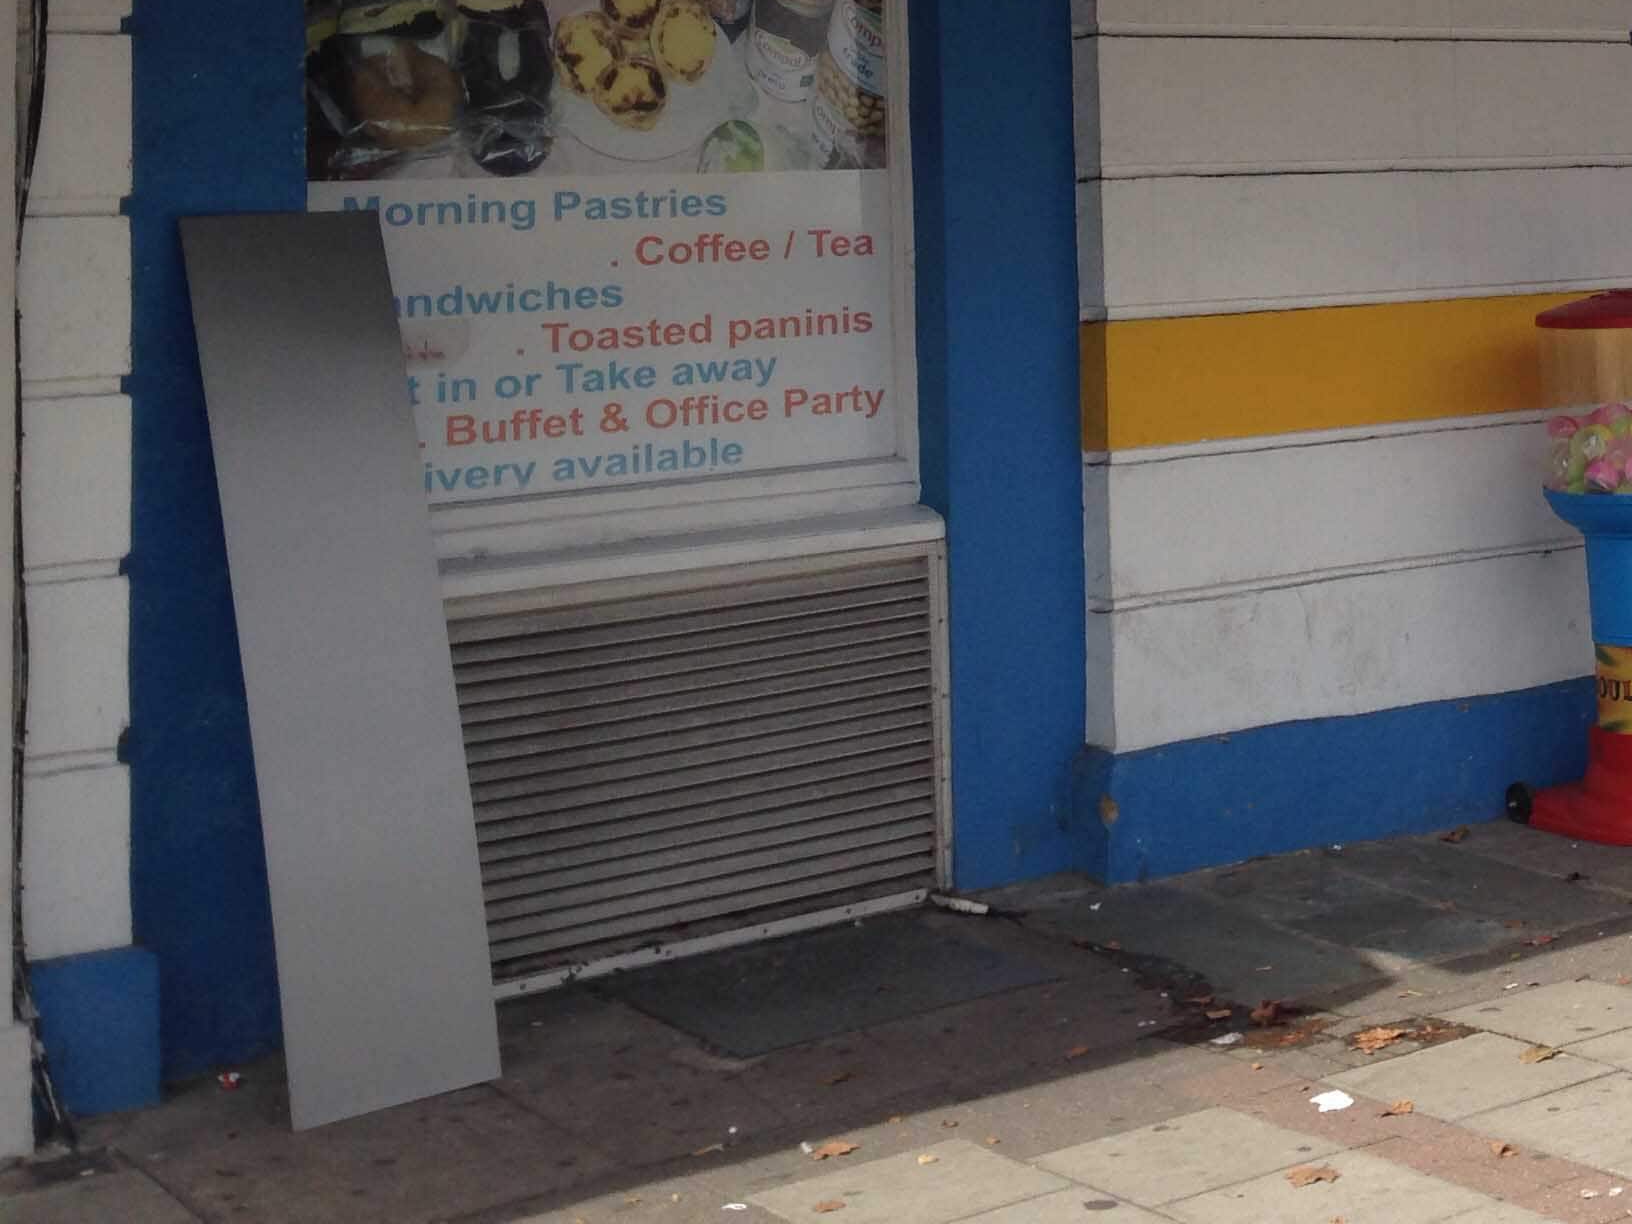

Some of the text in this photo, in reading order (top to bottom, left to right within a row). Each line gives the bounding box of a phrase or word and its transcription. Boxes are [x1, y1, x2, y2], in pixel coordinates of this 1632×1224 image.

[343, 190, 728, 231] Morning Pastries
[635, 229, 875, 267] Coffee / Tea
[392, 281, 625, 318] ndwiches
[541, 306, 873, 354] Toasted paninis
[437, 373, 476, 404] in
[495, 373, 542, 399] or
[557, 359, 656, 395] Take
[672, 355, 777, 387] away
[446, 384, 885, 449] Buffet & Office Party
[424, 438, 744, 494] ivery available
